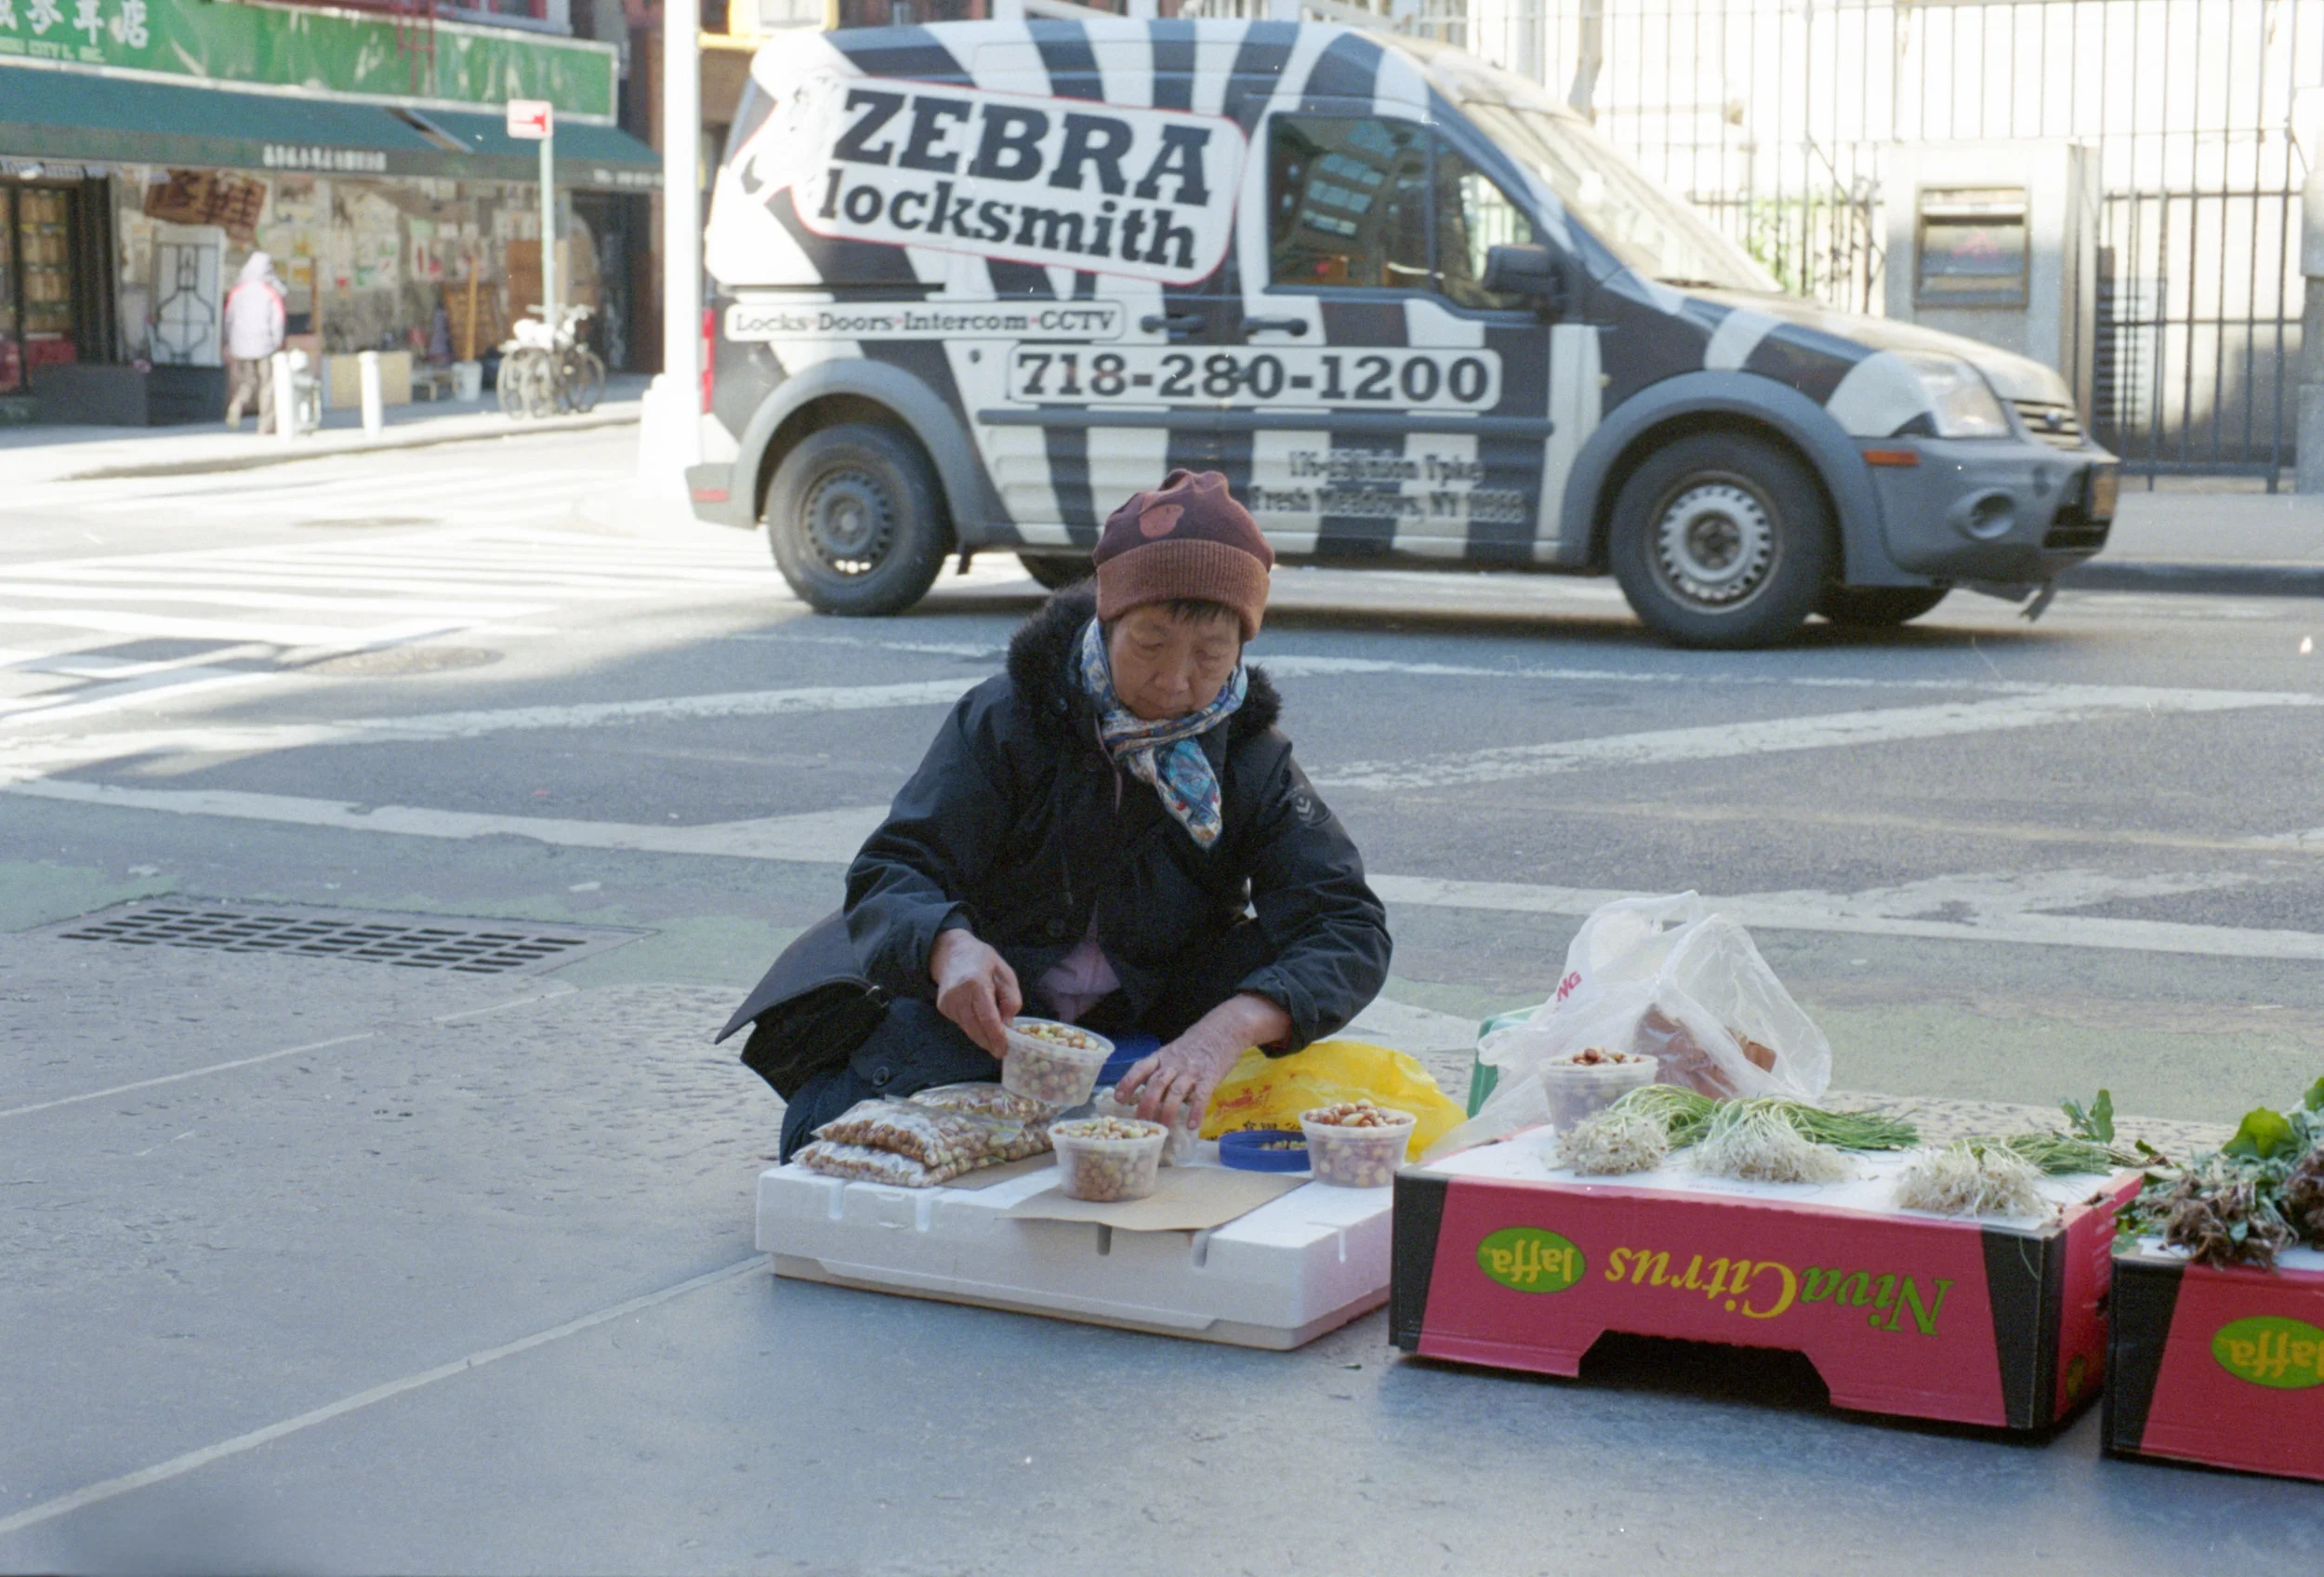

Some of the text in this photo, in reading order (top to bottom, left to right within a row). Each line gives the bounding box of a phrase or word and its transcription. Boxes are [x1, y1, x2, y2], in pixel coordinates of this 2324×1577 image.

[835, 89, 1211, 206] ZEBRA
[818, 168, 1195, 270] locksmith
[817, 312, 893, 333] Doors
[904, 311, 1028, 332] Intercom
[1039, 310, 1116, 331] CCTV
[1019, 353, 1488, 404] 718-280-1200
